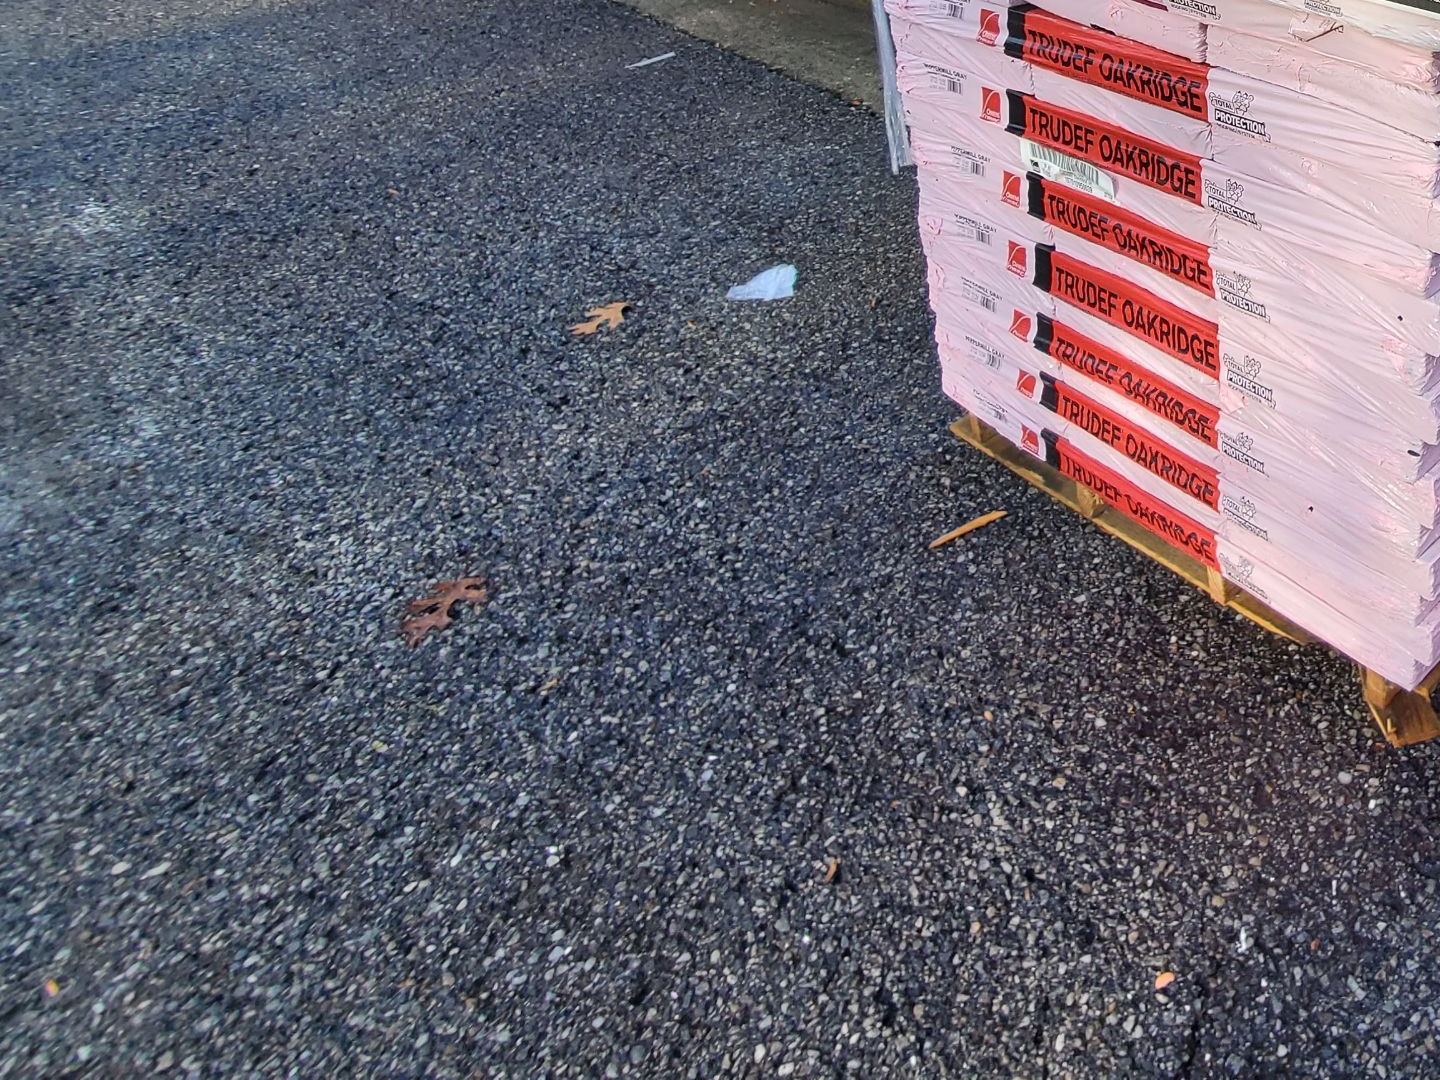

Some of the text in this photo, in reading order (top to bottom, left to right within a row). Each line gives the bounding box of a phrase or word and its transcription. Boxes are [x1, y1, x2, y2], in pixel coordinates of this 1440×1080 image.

[1028, 30, 1202, 113] TRUDEF OAKRIDGE
[1029, 108, 1095, 154] TRUDEF
[1099, 136, 1197, 200] OAKRIDGE
[1215, 110, 1266, 135] PROTECTION
[1048, 195, 1210, 290] TRUDEF OAKRIDGE
[1208, 197, 1257, 224] PROTECTION
[1055, 266, 1217, 370] TRUDEF OAKRIDGE
[1221, 289, 1266, 316] PROTECTION
[1056, 337, 1213, 442] TRUDEF OAKRIDGE
[1227, 372, 1274, 400] PROTECTION
[1062, 396, 1215, 508] TRUDEF OAKRIDGE
